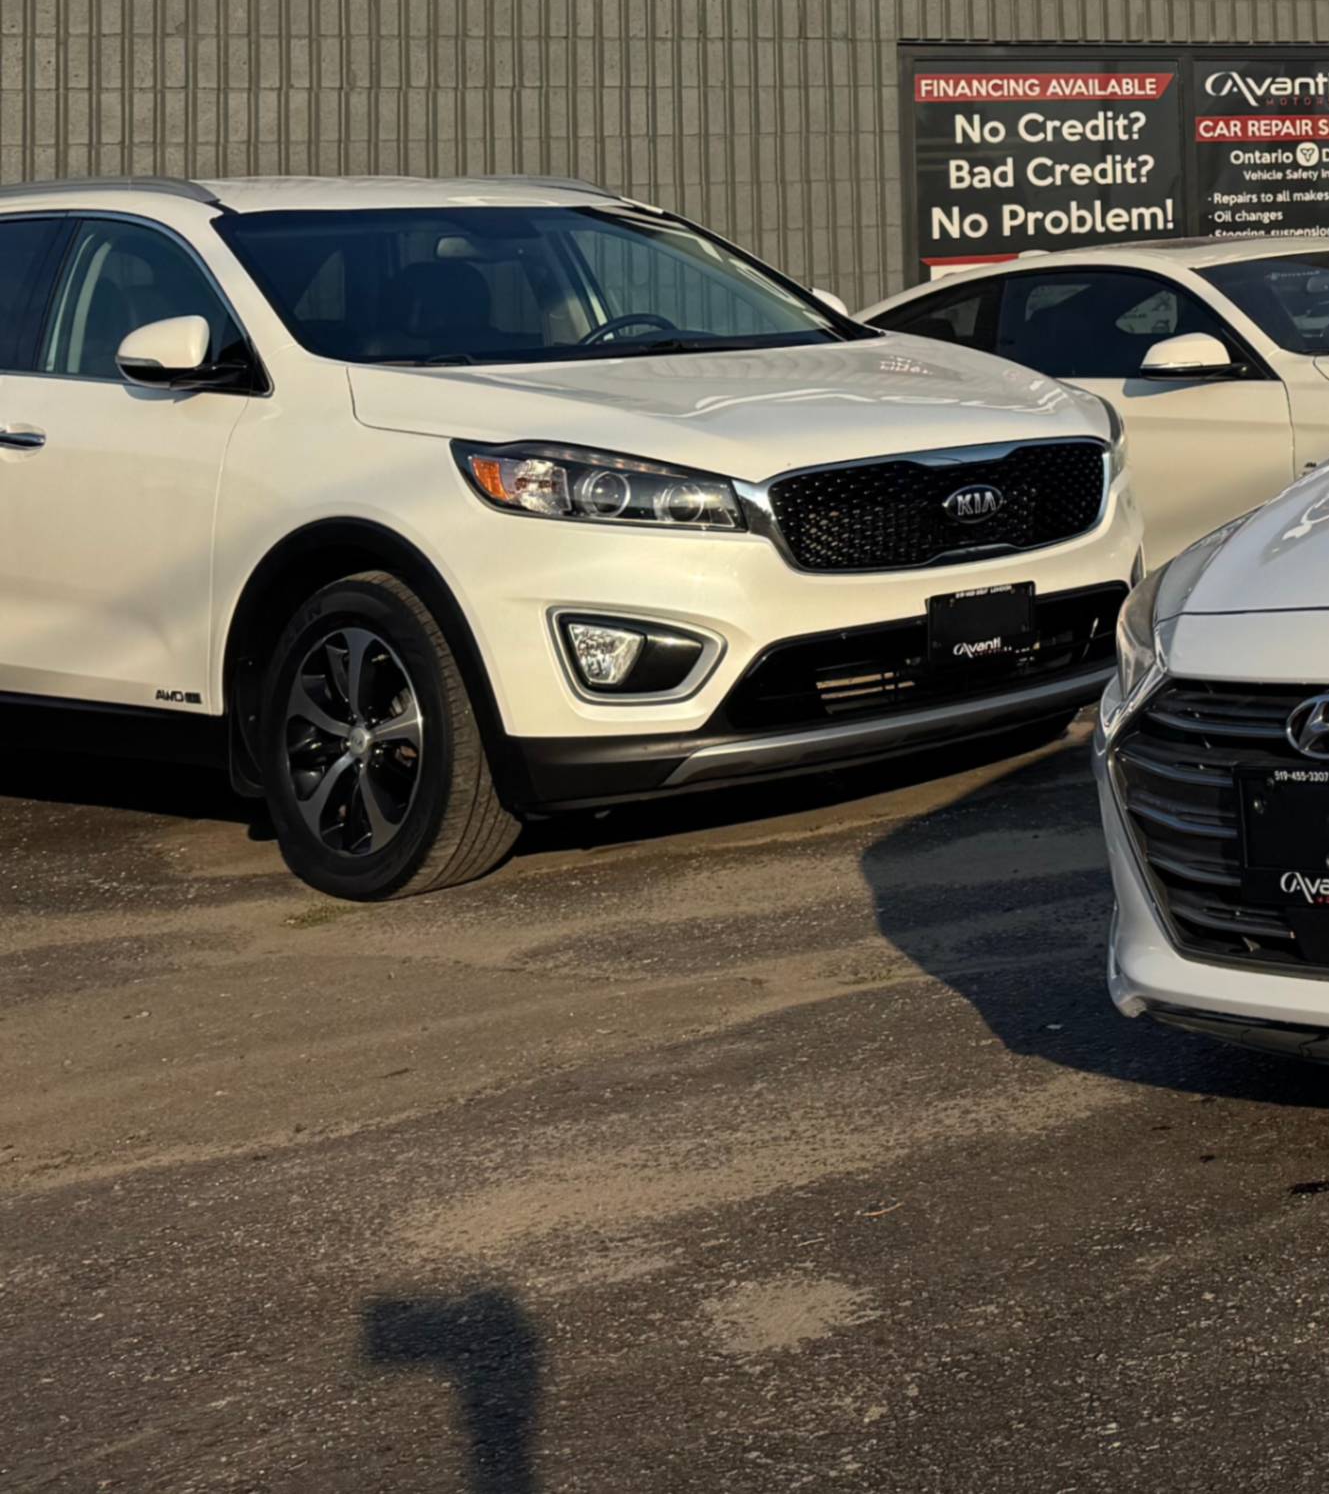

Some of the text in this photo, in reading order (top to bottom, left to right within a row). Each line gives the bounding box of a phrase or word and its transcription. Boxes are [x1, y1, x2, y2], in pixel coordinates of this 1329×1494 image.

[920, 78, 1157, 98] FINANCING AVAILABLE
[955, 111, 1147, 144] No Credit?
[1199, 120, 1242, 138] CAR
[1248, 119, 1313, 137] REPAIR
[1230, 149, 1293, 165] Ontario
[949, 155, 1155, 190] Bad Credit?
[1243, 169, 1284, 181] Vehicle
[1286, 169, 1319, 182] Safety
[1213, 192, 1258, 206] Repairs
[1261, 192, 1273, 203] to
[1276, 190, 1290, 203] all
[1293, 189, 1329, 202] makes
[931, 198, 1174, 240] No Problem!
[1214, 210, 1283, 224] Oil changes
[957, 491, 996, 516] KIA
[952, 636, 1001, 658] Avanti
[155, 689, 184, 703] AWD
